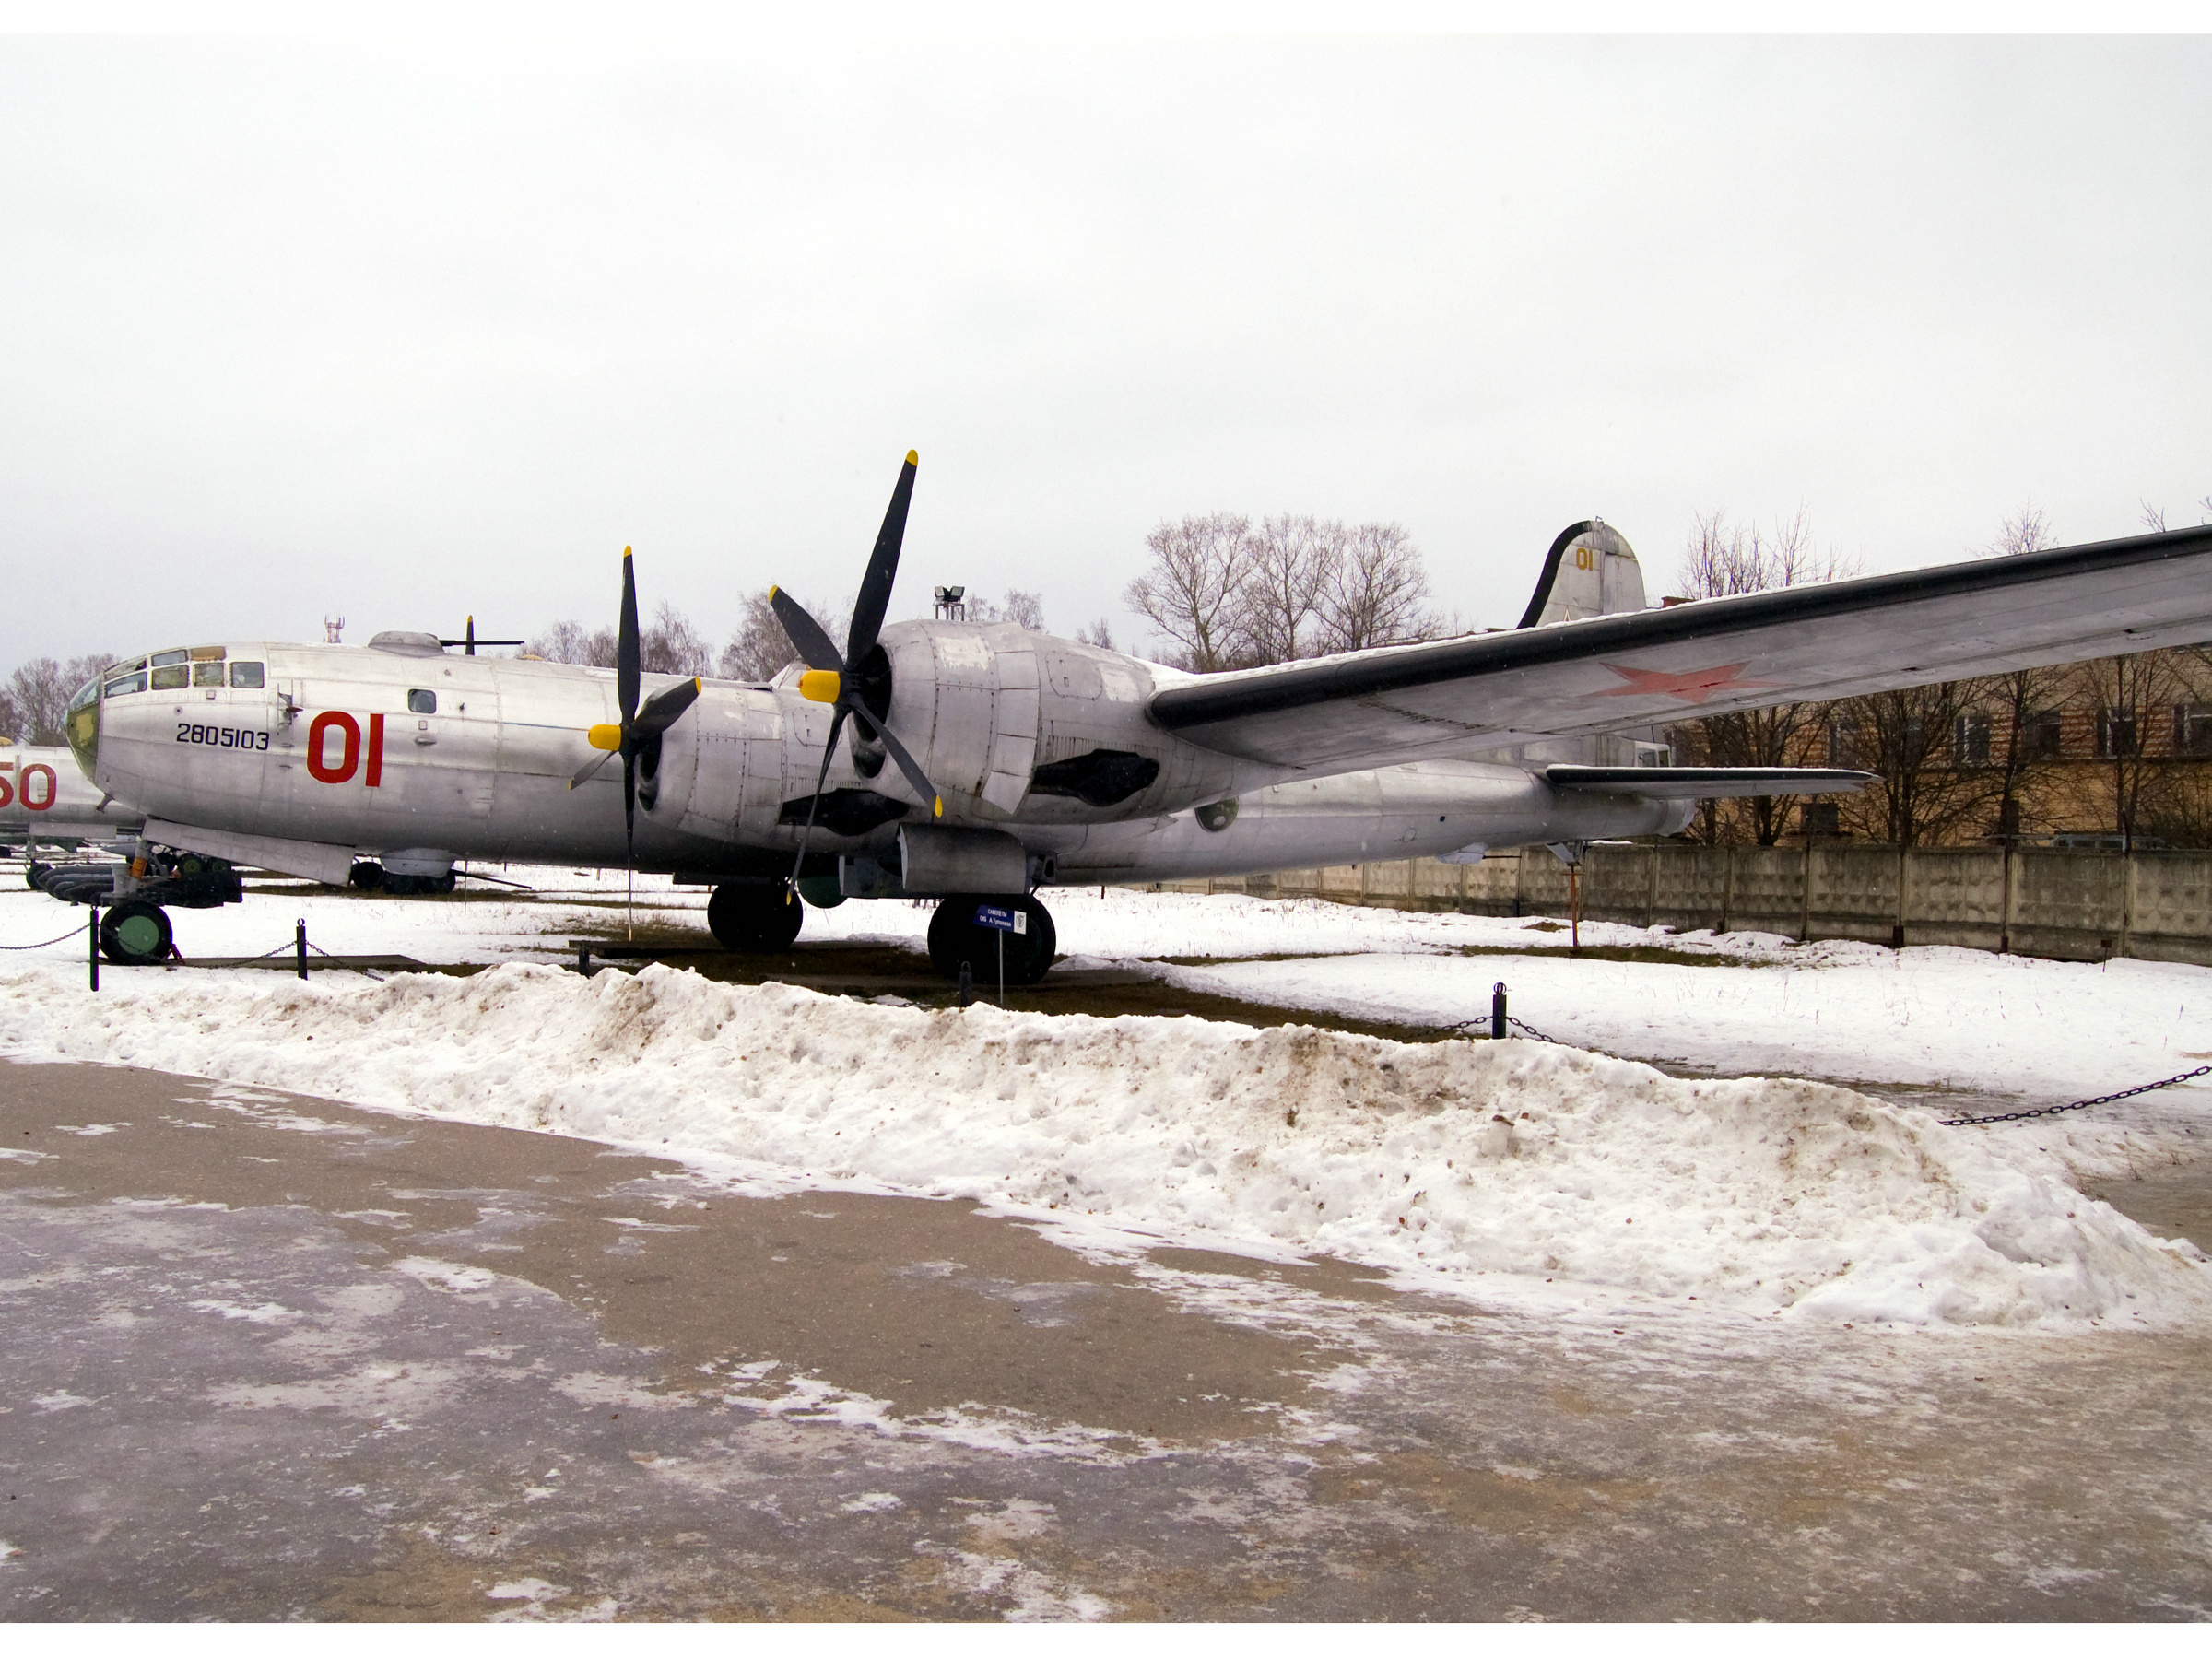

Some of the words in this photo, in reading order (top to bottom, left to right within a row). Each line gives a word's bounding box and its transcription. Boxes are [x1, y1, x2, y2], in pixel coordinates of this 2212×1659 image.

[1576, 547, 1593, 571] 01
[176, 723, 270, 751] 2805103
[307, 711, 384, 787] 01
